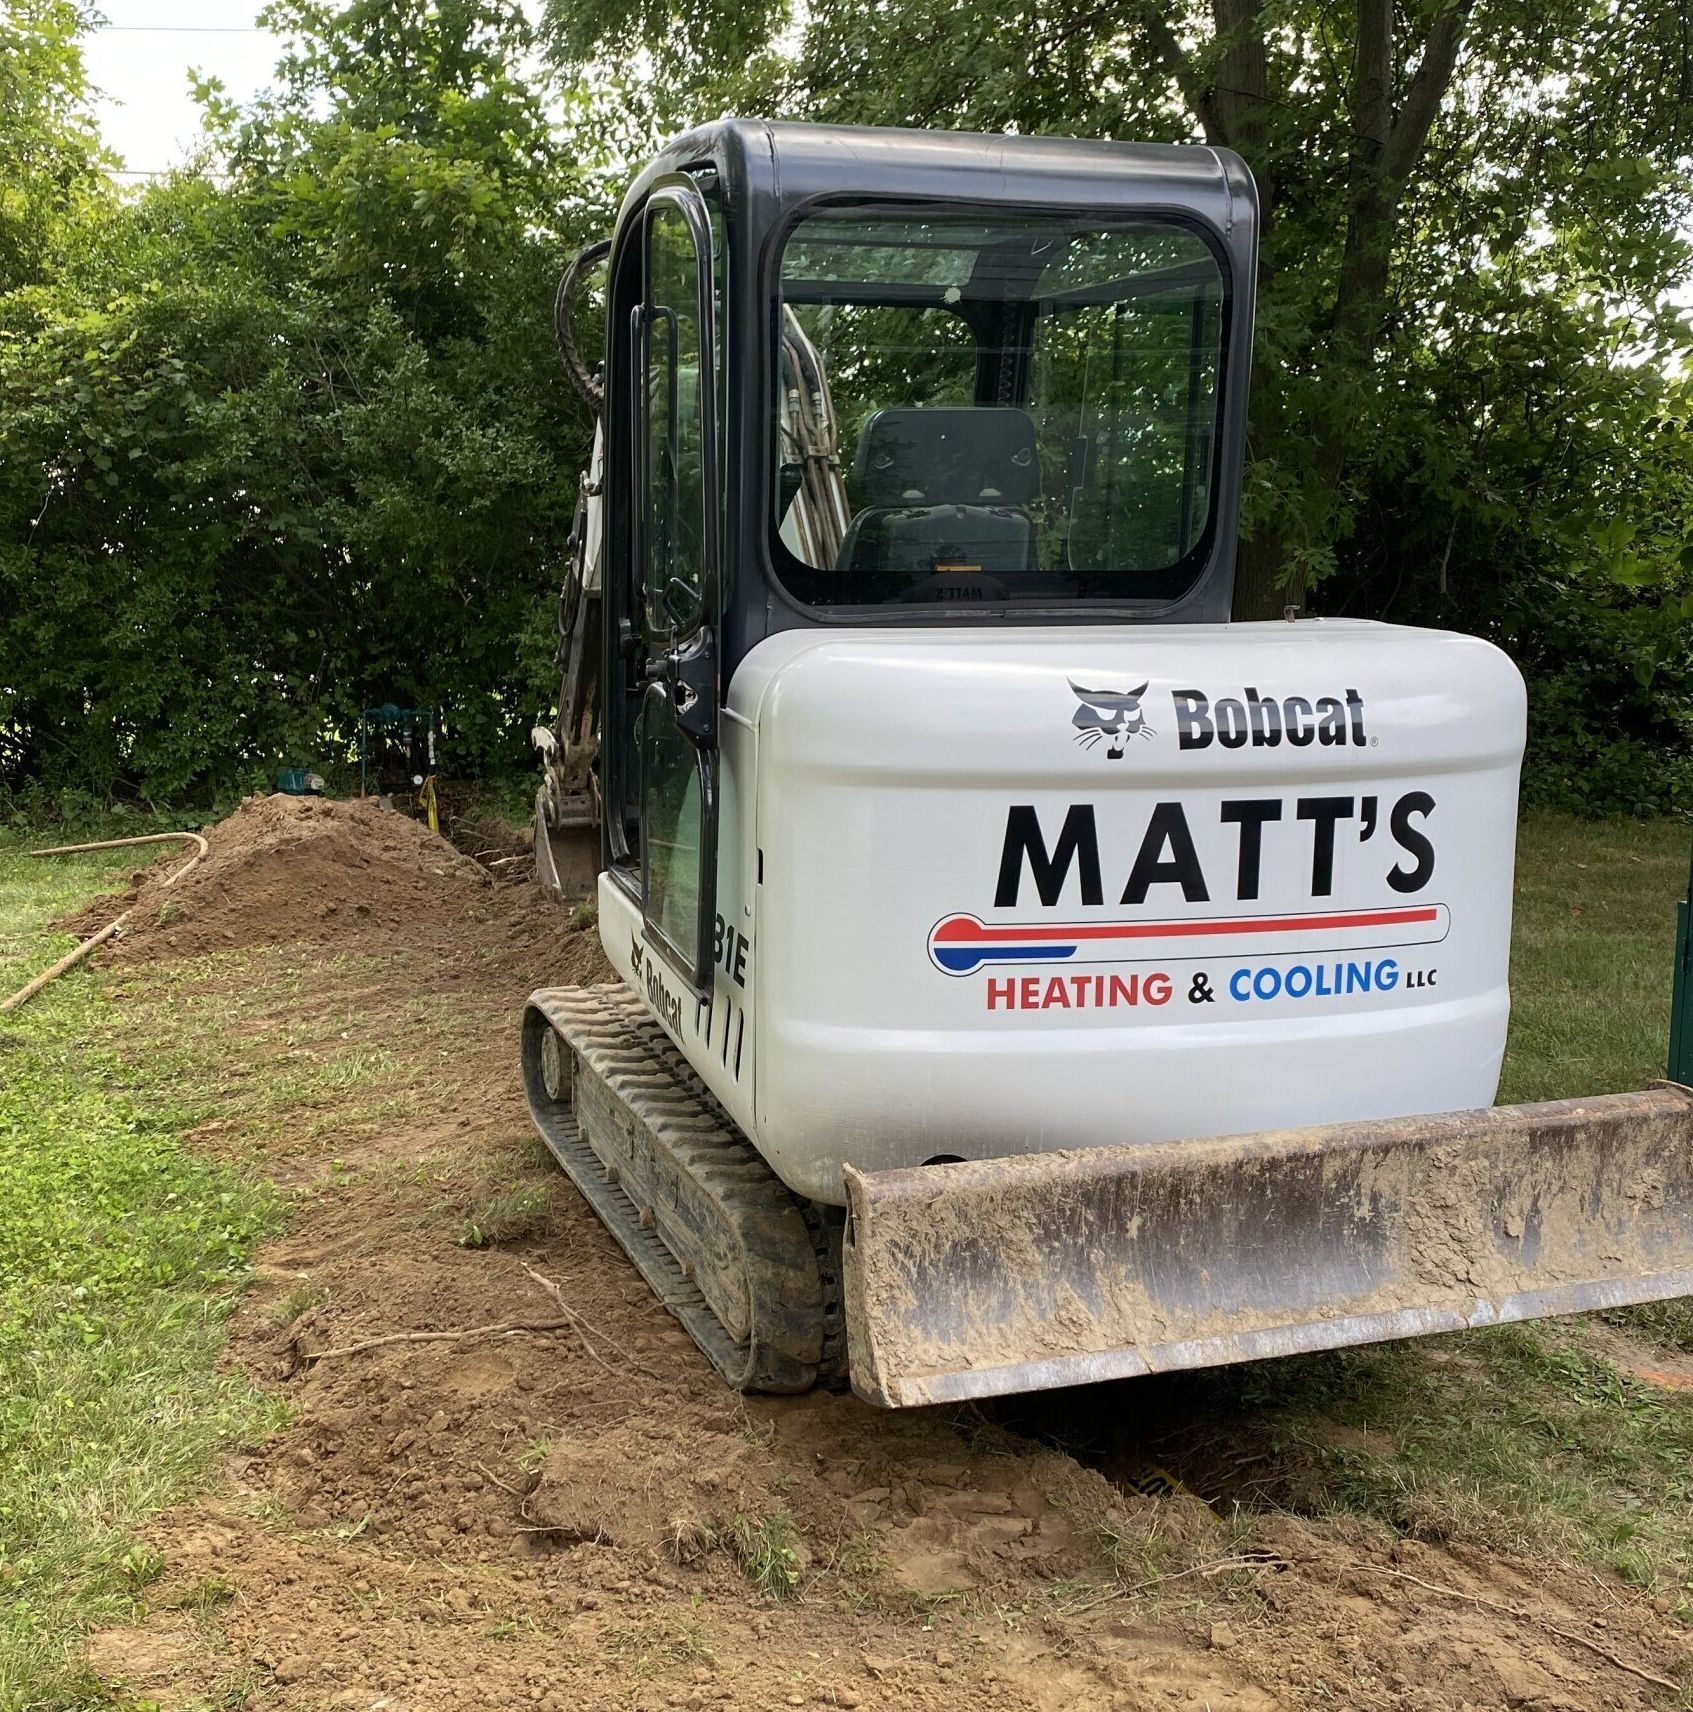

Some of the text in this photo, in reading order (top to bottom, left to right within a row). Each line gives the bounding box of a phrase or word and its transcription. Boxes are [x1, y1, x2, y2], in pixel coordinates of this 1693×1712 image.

[1172, 687, 1367, 751] Bobcat
[994, 791, 1437, 908] MATT'S
[646, 957, 686, 1045] Bobcat
[987, 959, 1437, 1010] HEATING & COOLING LLC
